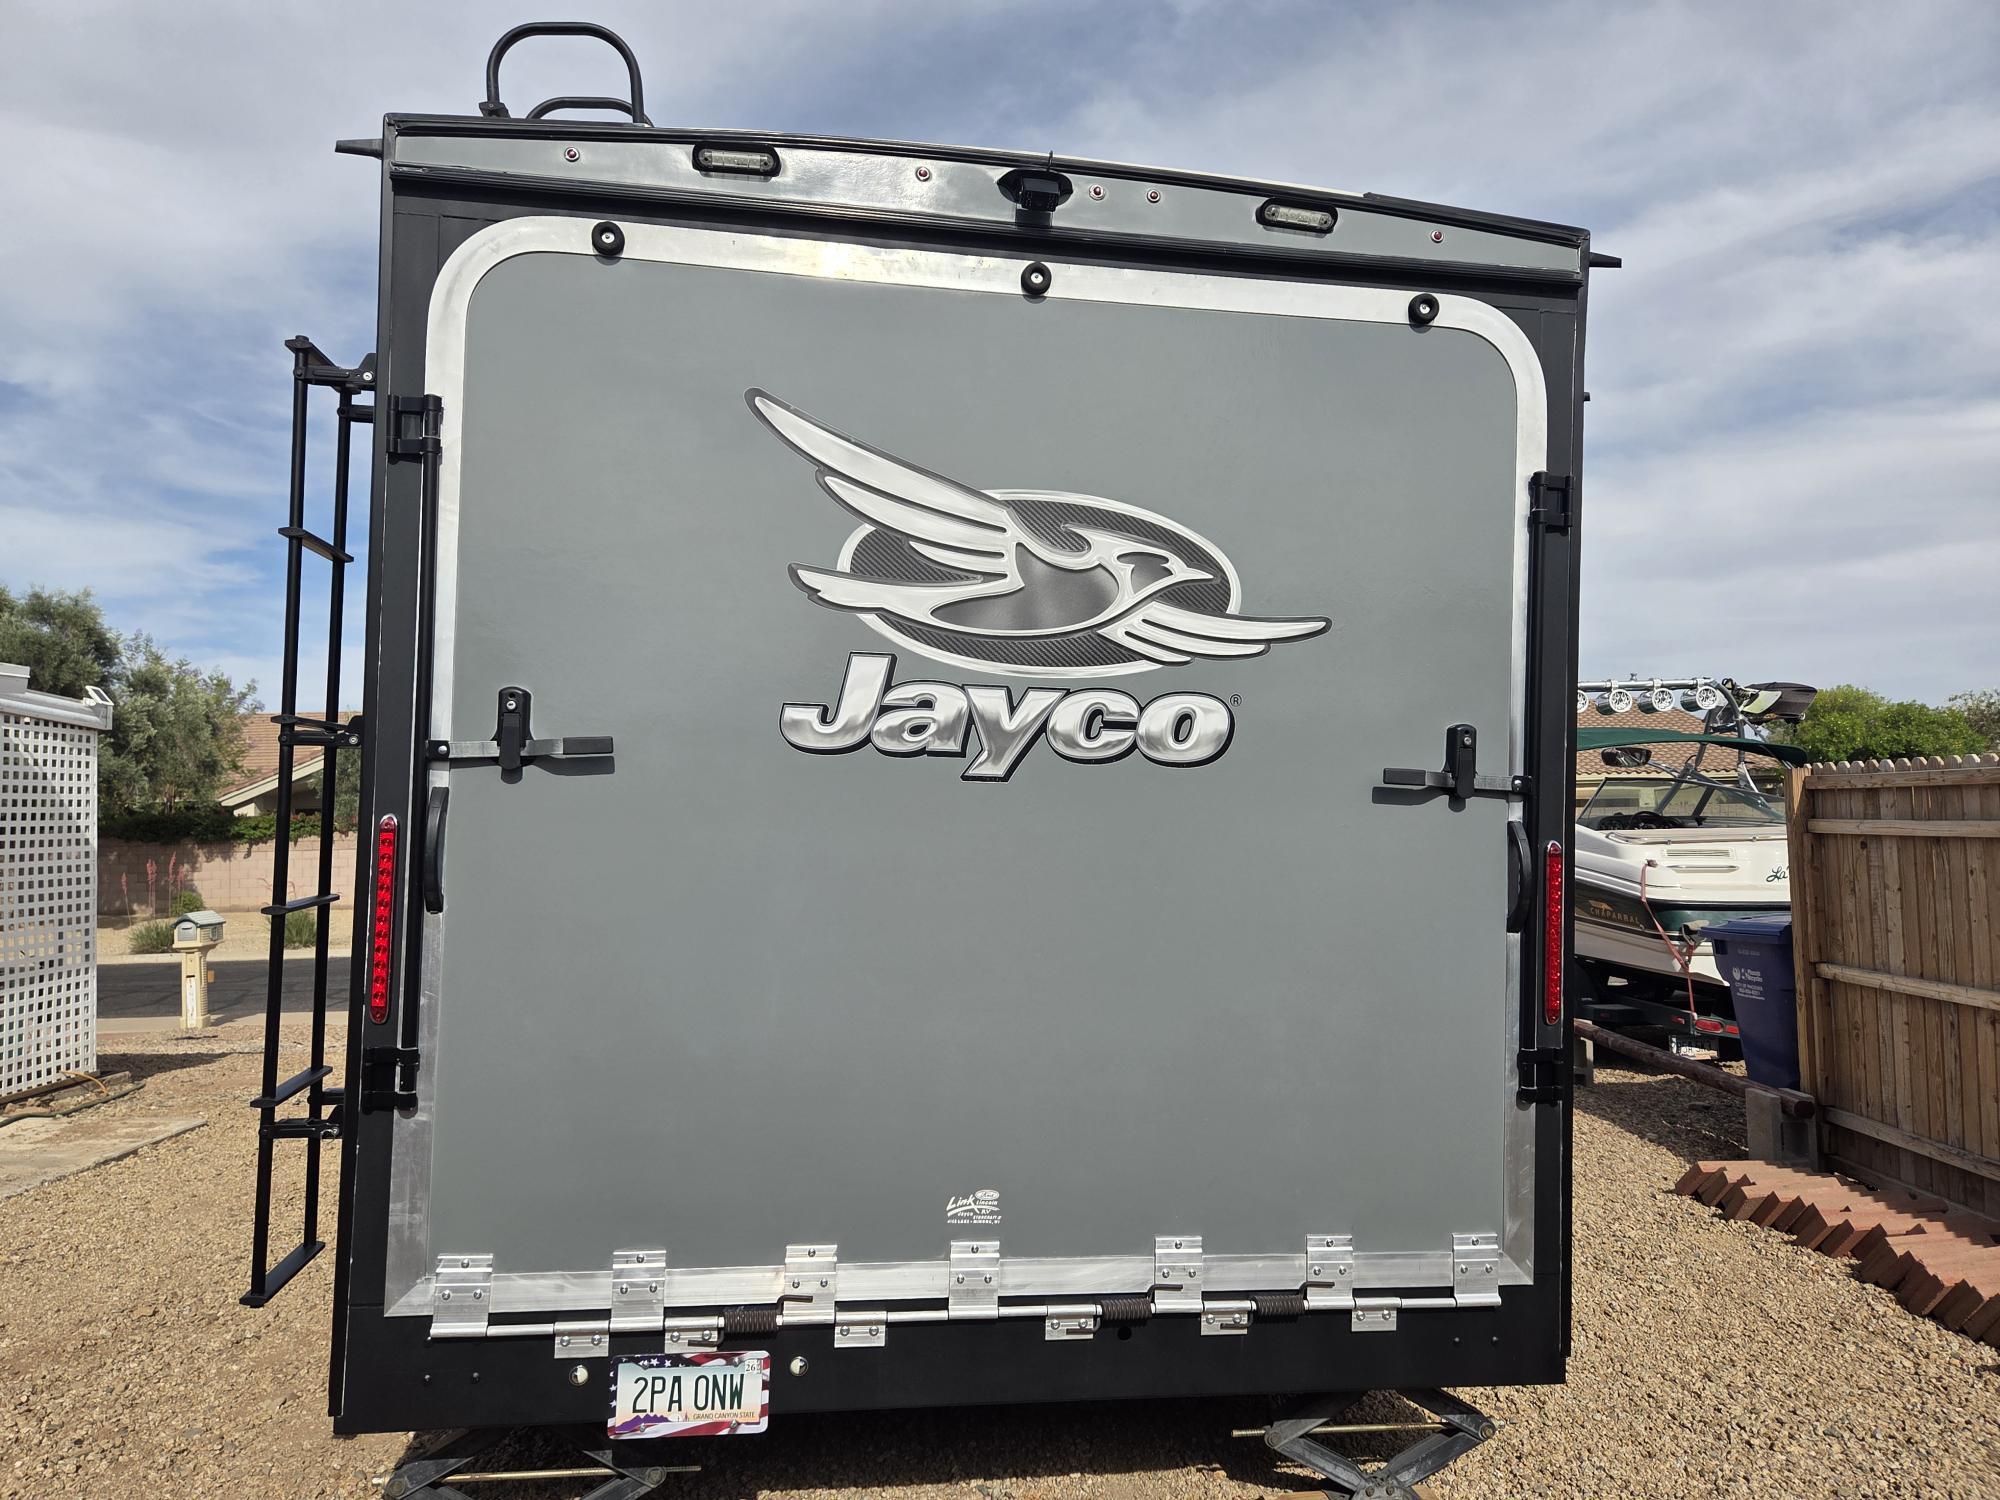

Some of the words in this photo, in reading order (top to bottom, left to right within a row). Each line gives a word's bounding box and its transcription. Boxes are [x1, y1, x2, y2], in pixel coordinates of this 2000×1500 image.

[780, 651, 1236, 783] Jayco
[1590, 907, 1640, 924] CHAPARRAL
[946, 1194, 980, 1214] Link
[745, 1363, 756, 1372] 26
[632, 1375, 682, 1413] 2PA
[715, 1412, 737, 1420] CANYON
[739, 1411, 756, 1420] STATE
